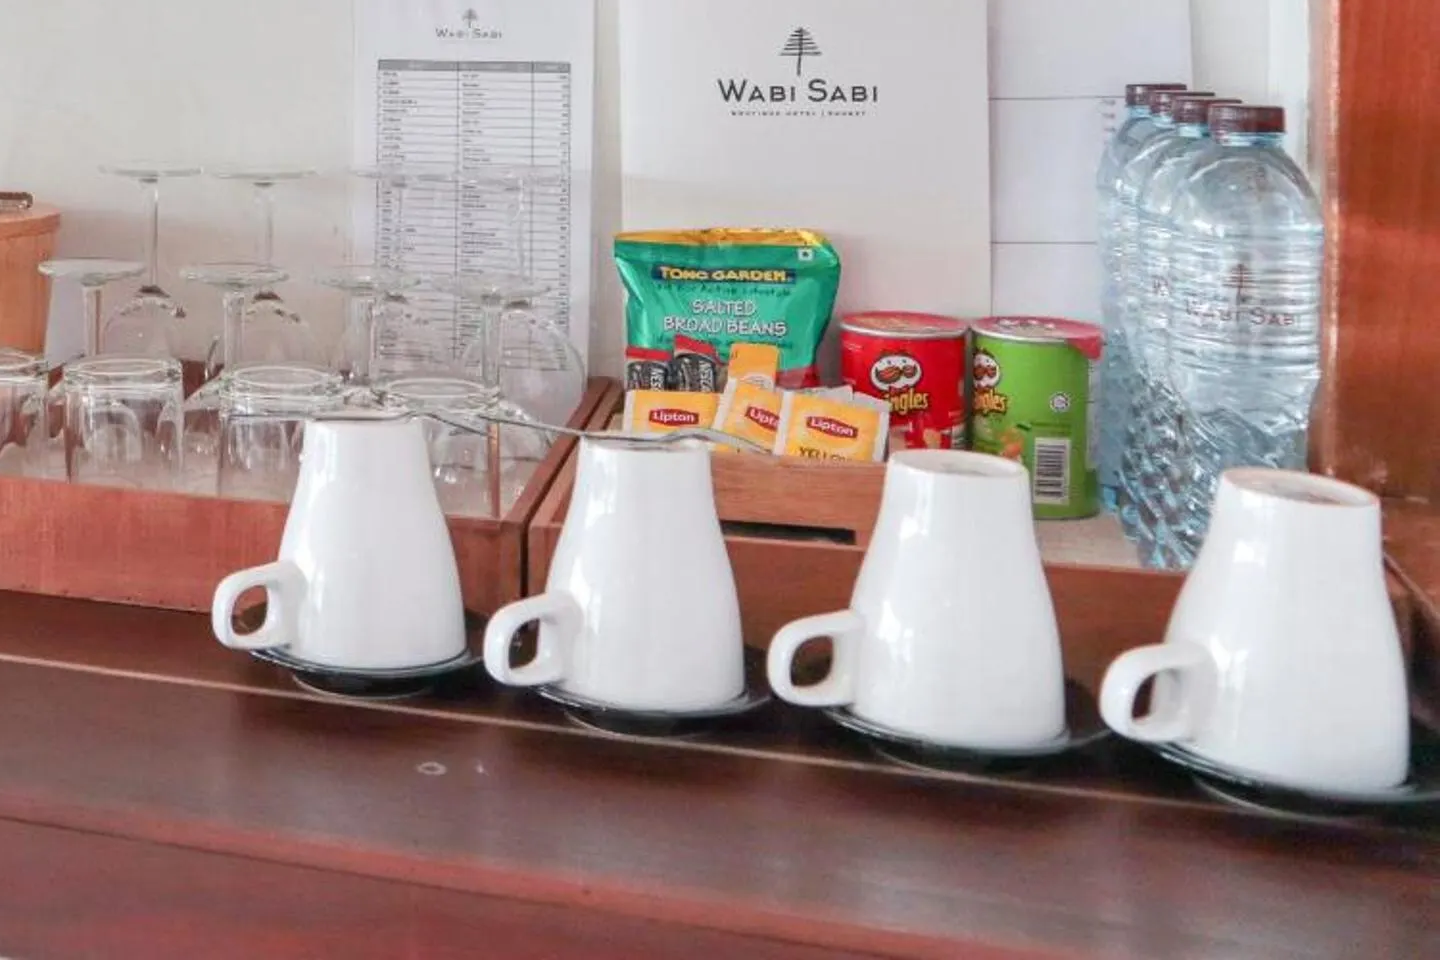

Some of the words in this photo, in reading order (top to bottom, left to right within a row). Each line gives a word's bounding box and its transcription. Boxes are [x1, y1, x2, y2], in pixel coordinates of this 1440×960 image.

[658, 265, 709, 281] TONG
[711, 267, 788, 282] GARDEN
[691, 299, 757, 316] SALTED
[663, 315, 724, 334] BROAD
[726, 319, 788, 337] BEANS
[885, 388, 929, 415] ngles
[651, 409, 696, 424] Lipton
[810, 416, 855, 437] Lipton
